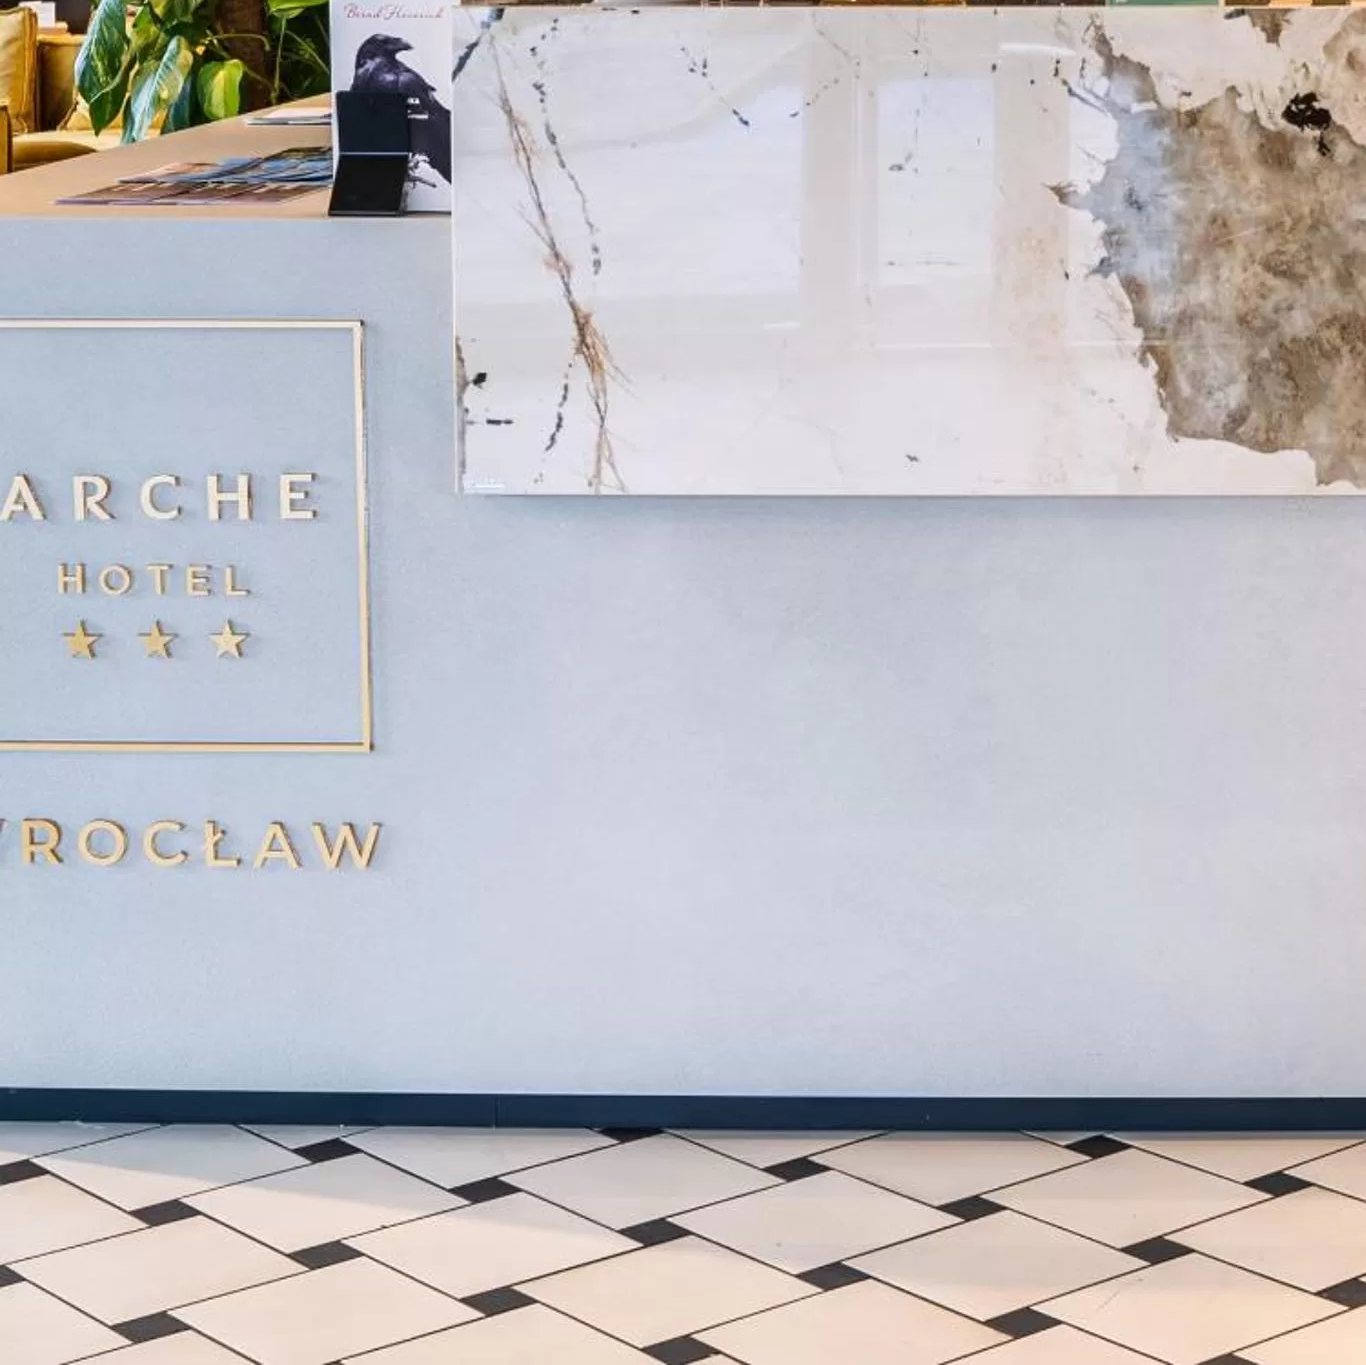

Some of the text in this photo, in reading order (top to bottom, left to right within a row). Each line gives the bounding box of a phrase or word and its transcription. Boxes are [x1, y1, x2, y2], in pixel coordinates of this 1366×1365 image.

[0, 472, 321, 522] ARCHE
[57, 562, 251, 597] HOTEL
[0, 817, 383, 872] ROCŁAW
